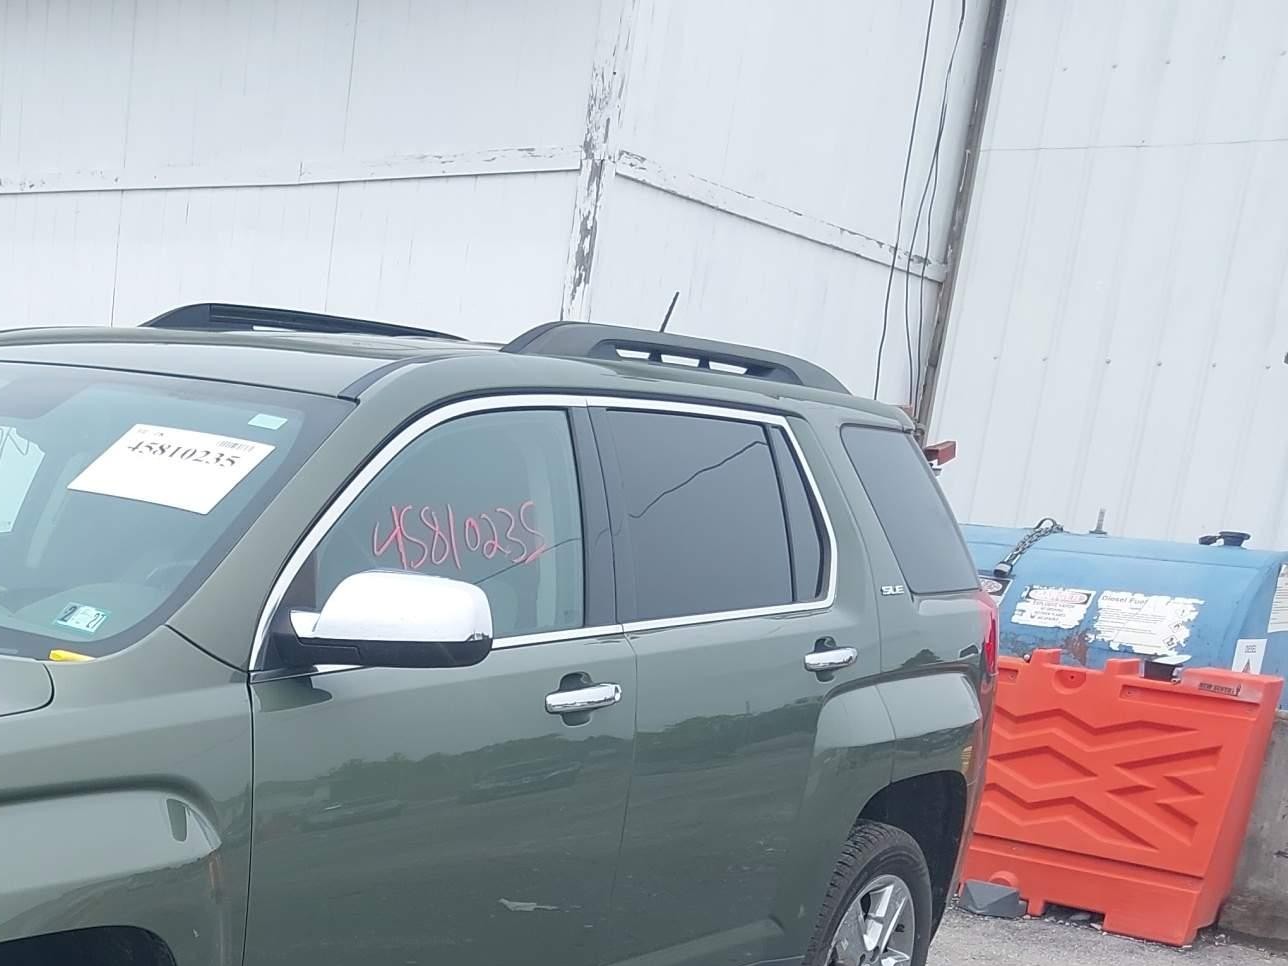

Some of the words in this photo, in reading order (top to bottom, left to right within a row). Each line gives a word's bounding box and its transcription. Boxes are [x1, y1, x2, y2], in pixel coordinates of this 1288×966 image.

[127, 440, 241, 468] 45810235
[373, 500, 547, 571] 45810235
[881, 585, 905, 595] SLE
